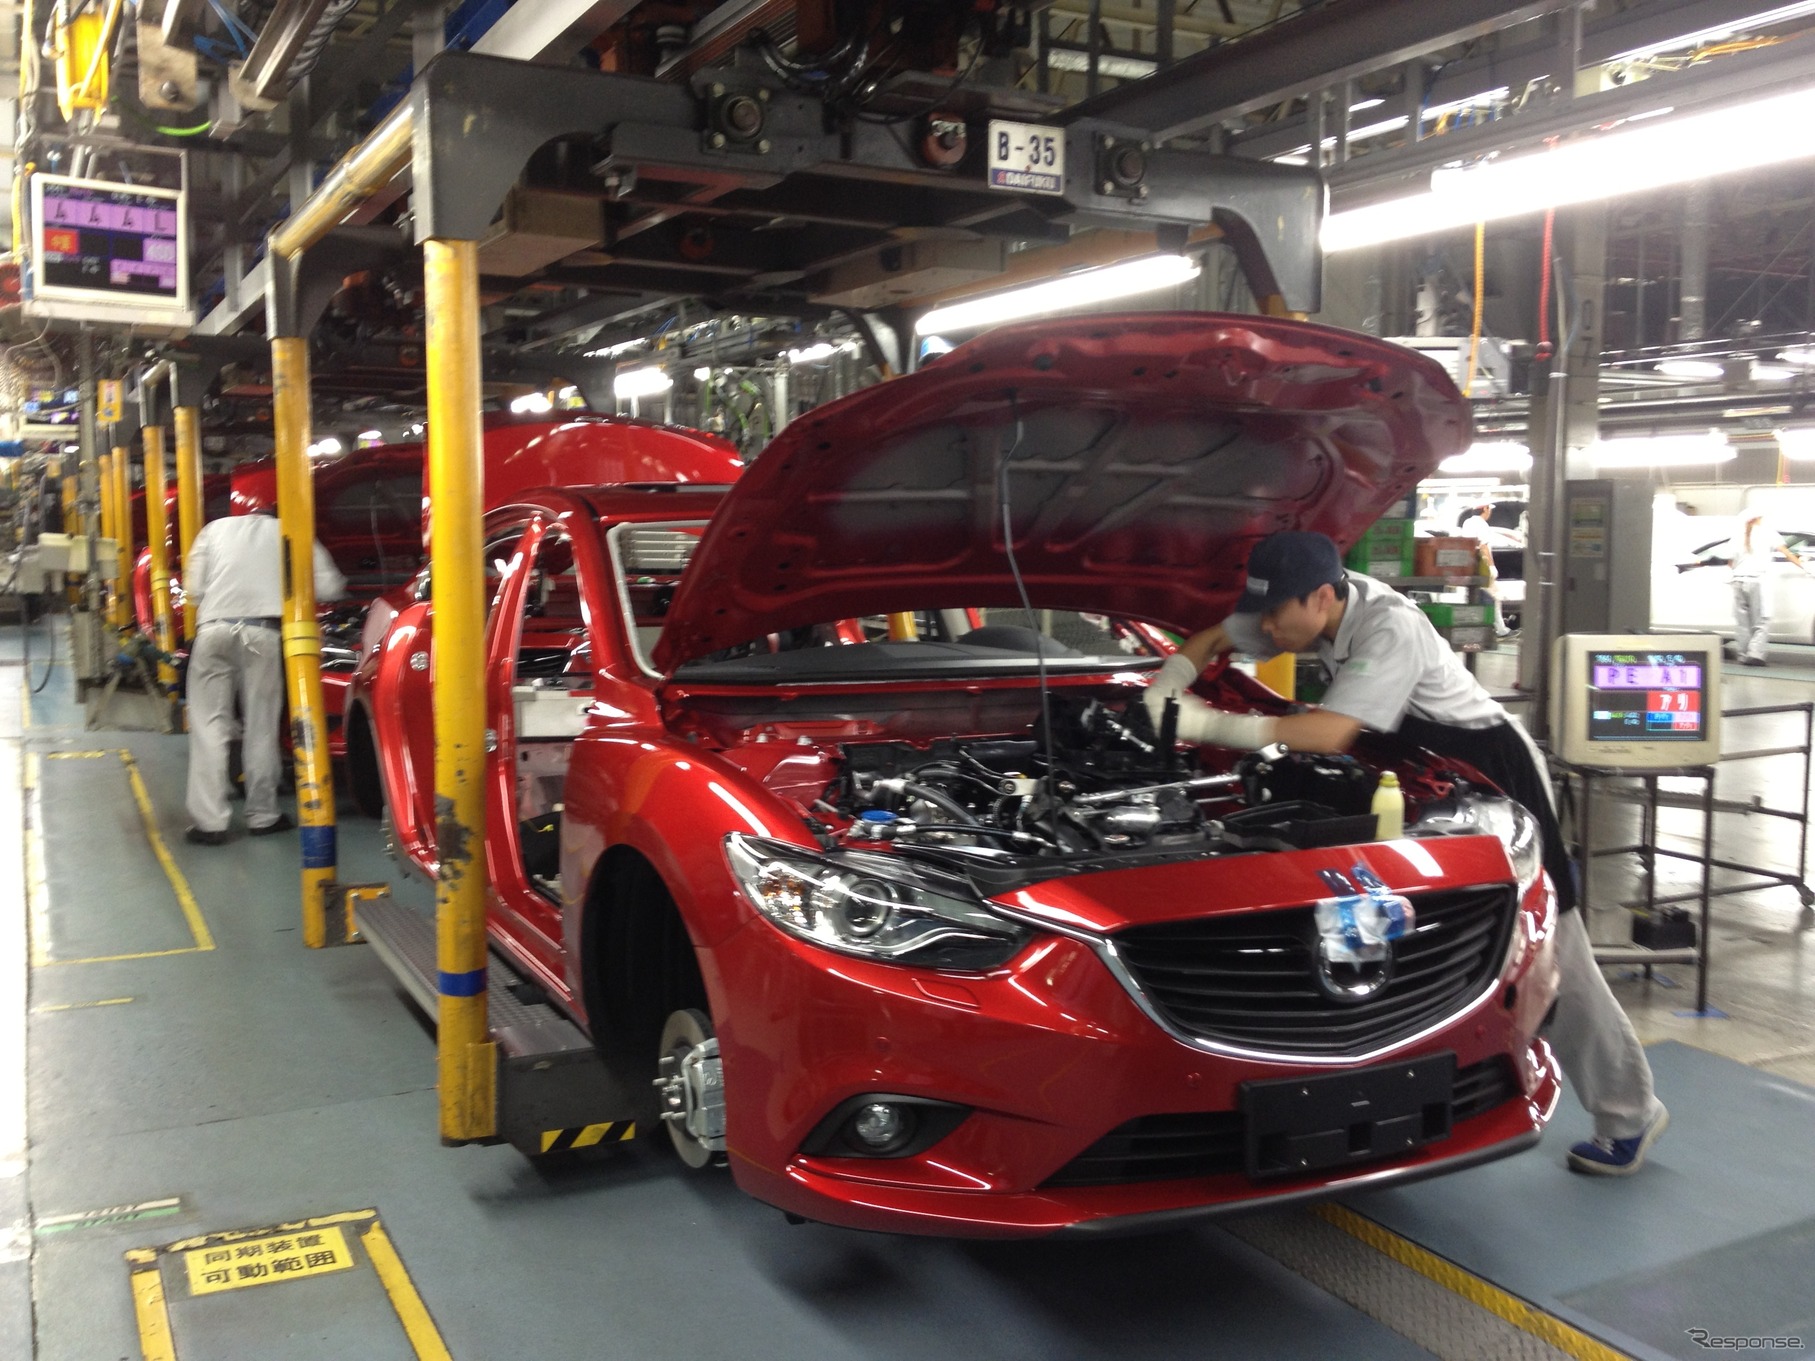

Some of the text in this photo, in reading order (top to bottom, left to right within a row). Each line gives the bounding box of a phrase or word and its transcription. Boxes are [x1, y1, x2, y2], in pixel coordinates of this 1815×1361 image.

[998, 131, 1056, 166] B-35
[205, 1234, 324, 1264] 同期装置
[202, 1251, 337, 1284] 可動範囲
